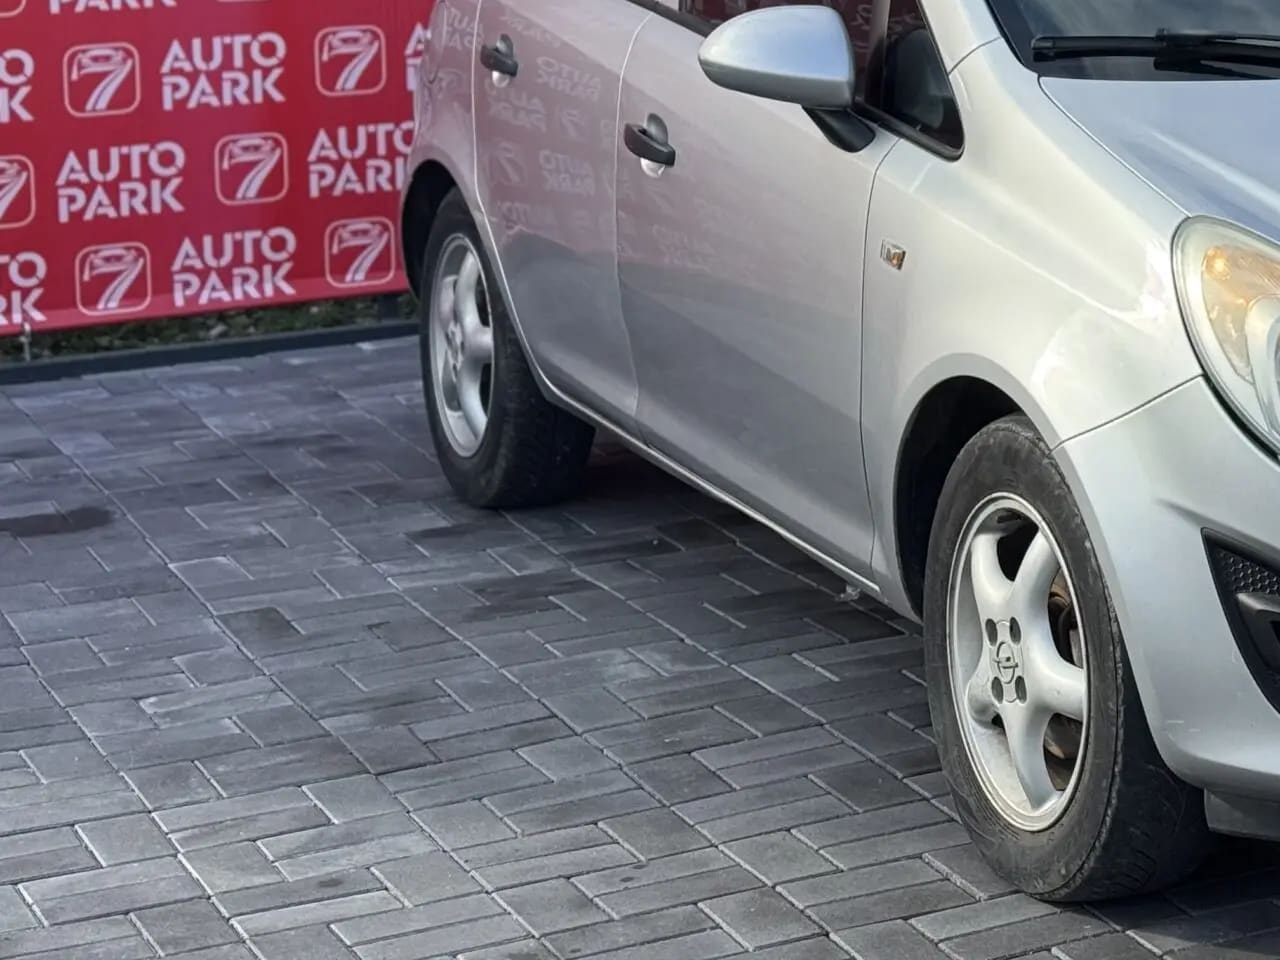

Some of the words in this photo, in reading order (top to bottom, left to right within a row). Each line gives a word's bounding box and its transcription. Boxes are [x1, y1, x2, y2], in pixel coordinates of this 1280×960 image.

[160, 32, 286, 75] AUTO
[162, 66, 284, 111] PARK
[56, 141, 185, 187] AUTO
[58, 176, 184, 223] PARK
[171, 227, 296, 273] AUTO
[173, 262, 297, 308] PARK
